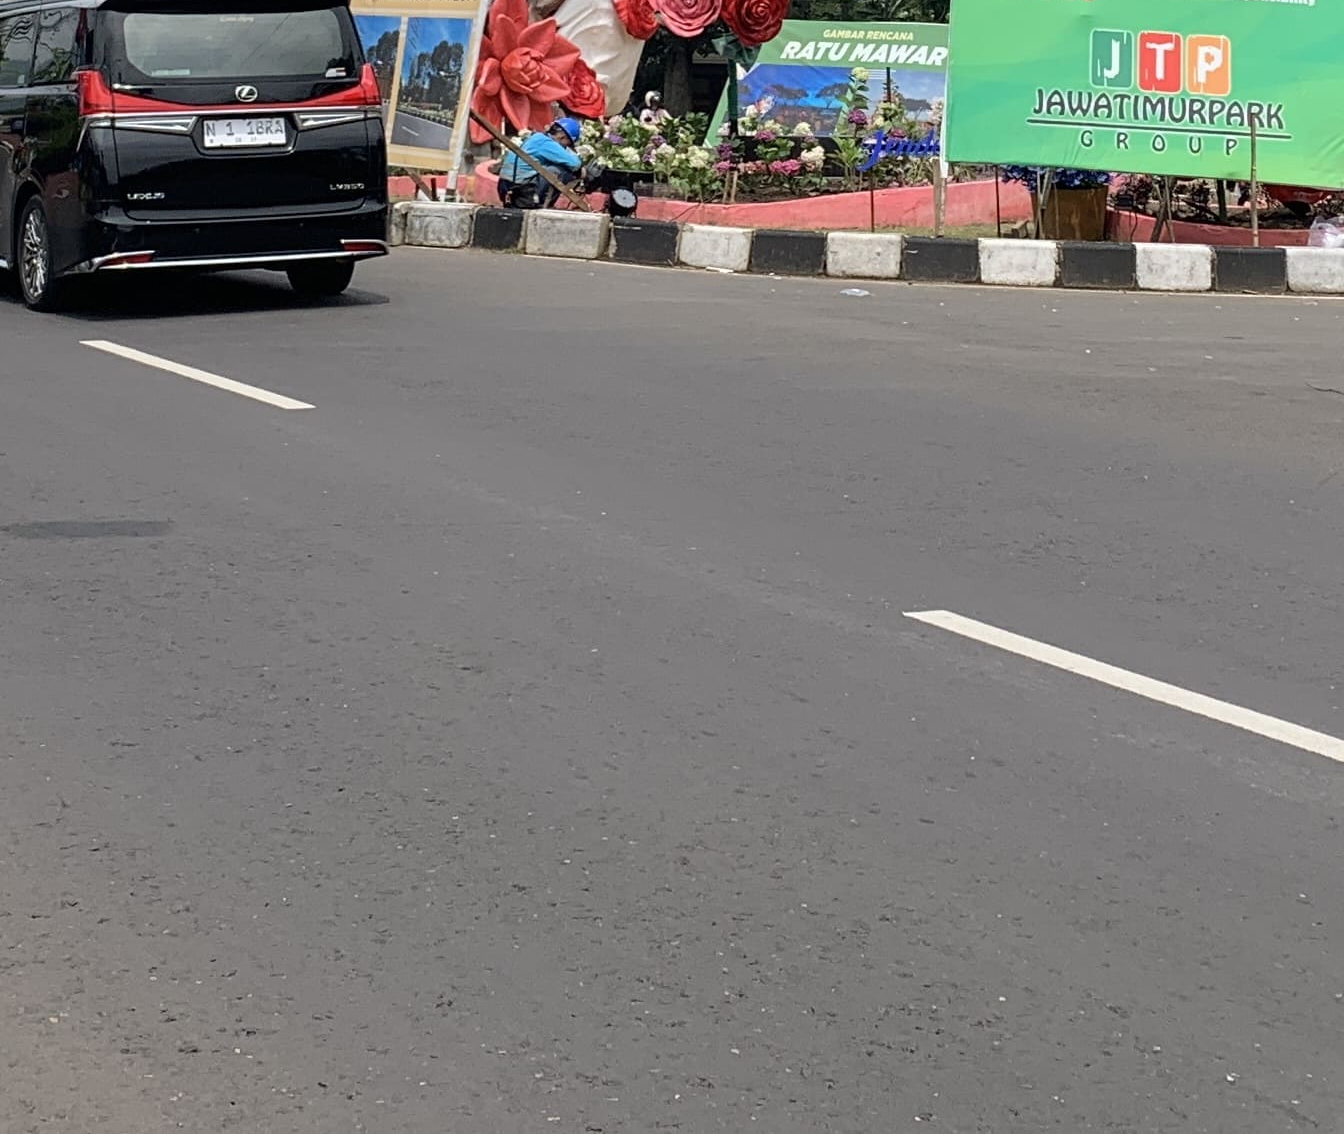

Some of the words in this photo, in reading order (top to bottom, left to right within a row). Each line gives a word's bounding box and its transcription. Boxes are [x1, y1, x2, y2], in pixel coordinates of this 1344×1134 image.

[823, 29, 864, 40] GAMBAR
[866, 30, 914, 41] RENCANA
[780, 41, 851, 61] RATU
[849, 43, 949, 66] MAWAR
[1102, 37, 1224, 85] JTP
[1033, 88, 1285, 130] JAWATIMURPARK
[1080, 130, 1238, 156] GROUP
